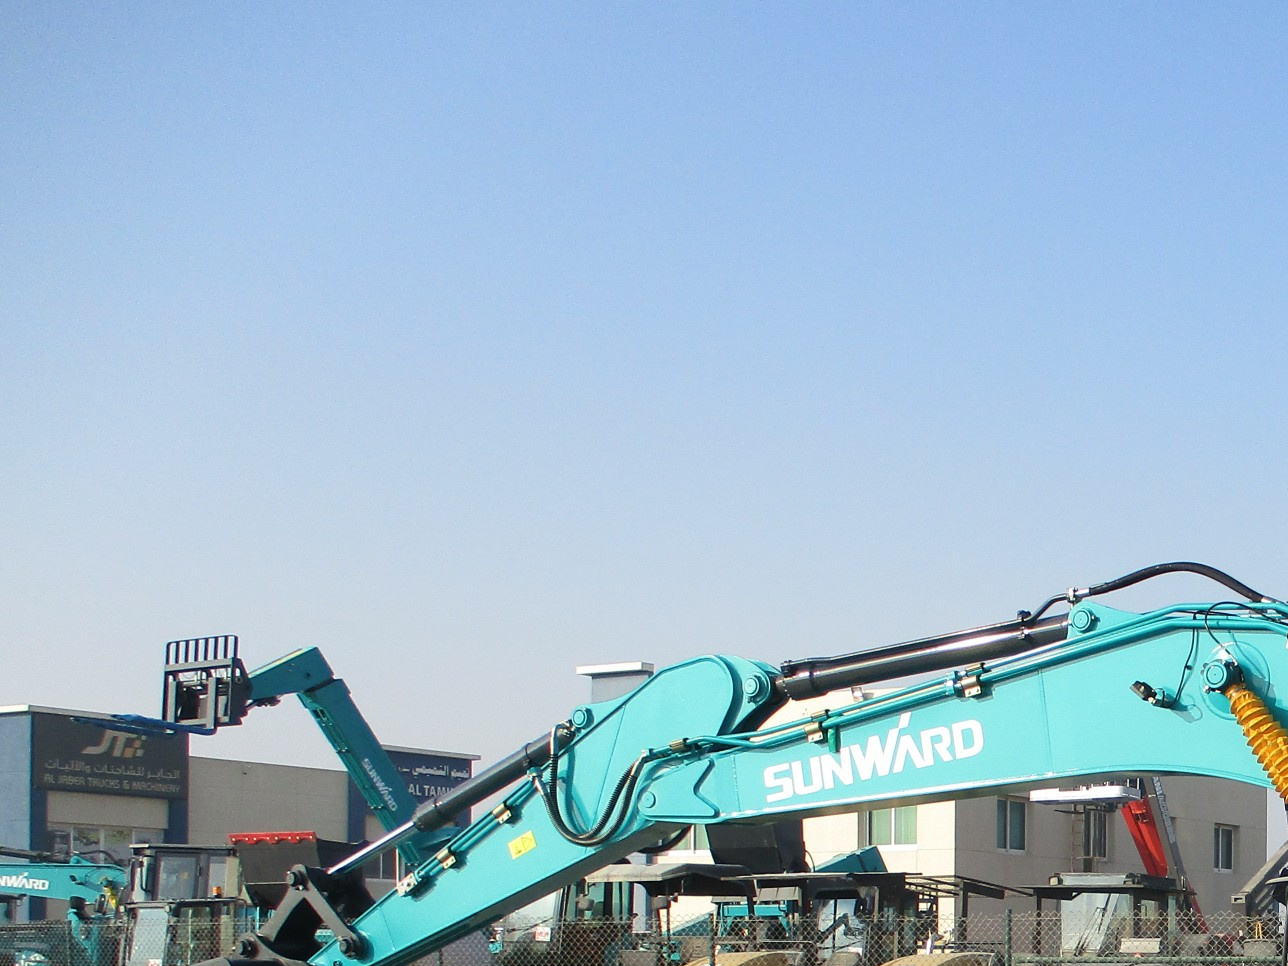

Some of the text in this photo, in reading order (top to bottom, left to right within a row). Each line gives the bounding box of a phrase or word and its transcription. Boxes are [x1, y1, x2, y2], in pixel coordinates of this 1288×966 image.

[763, 711, 984, 803] SUNWARD
[88, 777, 120, 790] TRUCKS
[132, 781, 181, 793] MACHINERY
[361, 758, 398, 811] SUNWARD
[408, 783, 421, 796] AL
